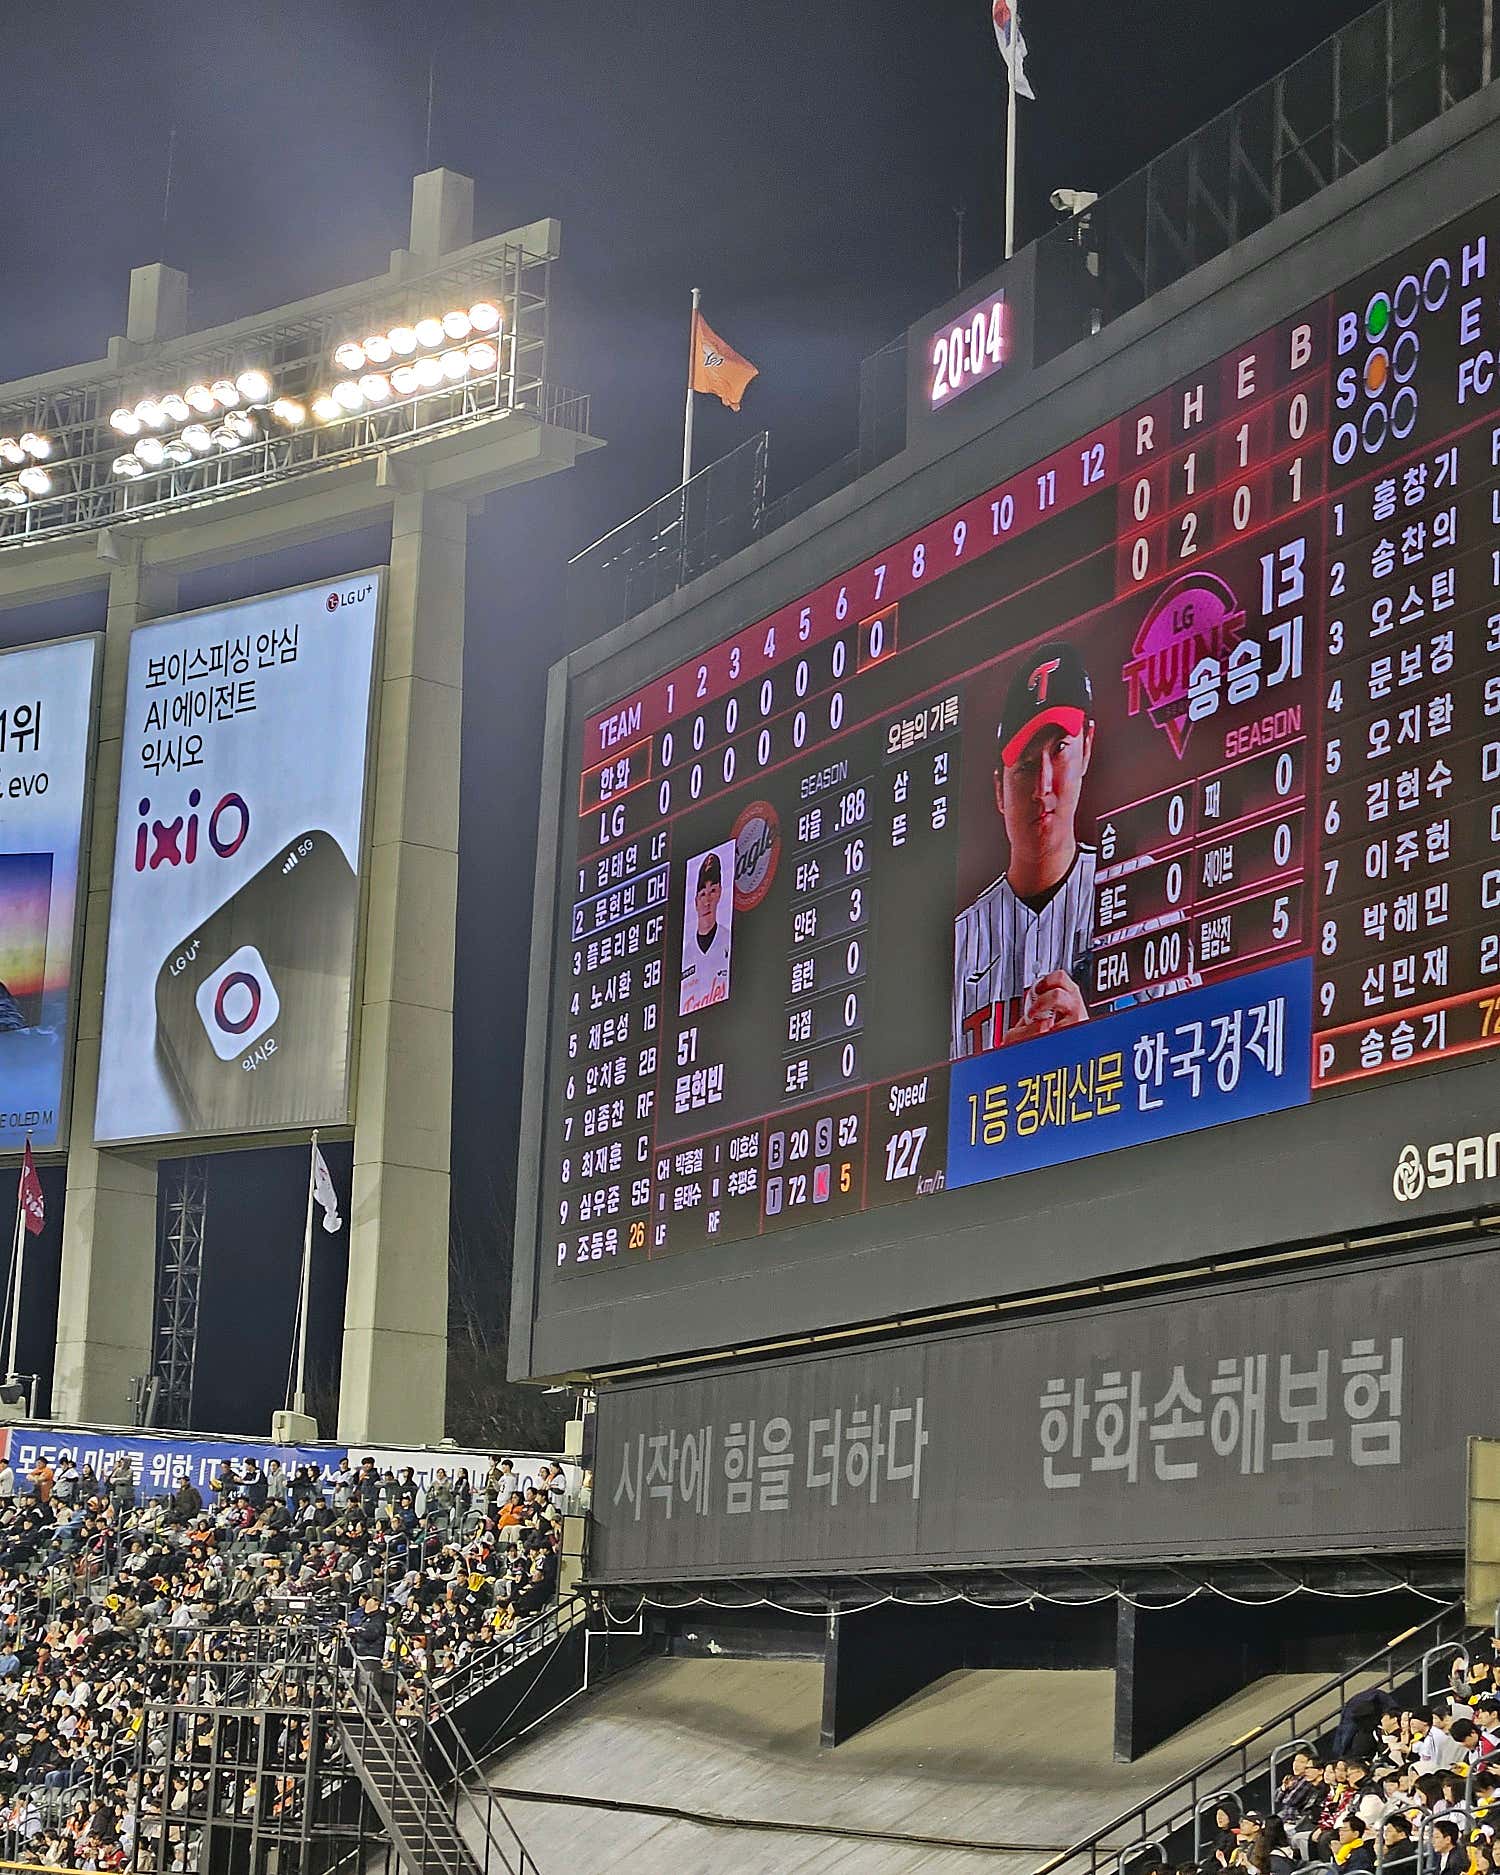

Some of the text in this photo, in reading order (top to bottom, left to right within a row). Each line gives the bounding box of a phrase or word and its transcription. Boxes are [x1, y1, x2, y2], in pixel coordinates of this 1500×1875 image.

[1462, 236, 1486, 286] H
[1338, 311, 1358, 356] B
[1460, 297, 1481, 346] E
[931, 302, 1005, 402] 20:04
[1458, 350, 1494, 404] FC
[1336, 367, 1357, 409] S
[1372, 447, 1458, 521] 홍창기
[600, 324, 1312, 750] TEAM 1 2 3 4 5 6 7 8 9 10 11 12 R H E B
[1371, 506, 1457, 579] 송찬의
[600, 393, 1308, 799] 한화 0 0 0 0 0 0 0 0 1 1 0
[1259, 537, 1306, 616] 13
[1369, 568, 1455, 638] 오스틴
[145, 623, 299, 689] 보이스피싱 안심
[600, 457, 1302, 845] LG 0 0 0 0 0 0 0 2 0 1
[1188, 615, 1303, 722] 송승기
[1368, 630, 1454, 700] 문보경
[144, 680, 256, 733] AI 에이전트
[887, 695, 959, 754] 오늘의 기록
[1224, 704, 1301, 759] SEASON
[1366, 692, 1453, 759] 오지환
[141, 734, 203, 776] 익시오
[801, 760, 848, 799] SEASON
[8, 772, 49, 798] evo
[1101, 752, 1292, 860] 승 0 패 0
[1366, 759, 1452, 822] 김현수
[798, 788, 865, 842] 타율 .188
[298, 839, 313, 857] 5G
[597, 832, 666, 888] 김태연 LF
[796, 839, 864, 891] 타수 16
[1365, 819, 1450, 879] 이주헌
[648, 873, 666, 903] DH
[1100, 824, 1291, 926] 홀드 0 세이브 0
[794, 888, 861, 943] 안타 3
[1363, 882, 1449, 942] 박해민
[587, 916, 663, 971] 플로리얼 CF
[791, 941, 859, 993] 홈런 0
[1097, 896, 1289, 992] ERA 0.00 탈삼진 5
[590, 960, 661, 1010] 노시환 3B
[1362, 945, 1448, 1007] 신민재
[589, 1004, 656, 1050] 채은성 1B
[789, 993, 856, 1041] 타점 0
[242, 1038, 279, 1072] 익시오
[678, 1028, 697, 1066] 51
[785, 1043, 855, 1093] 도루 0
[1319, 1010, 1446, 1078] P 송승기
[586, 1047, 657, 1095] 안치홍 2B
[675, 1063, 724, 1114] 문현빈
[889, 1077, 928, 1116] Speed
[968, 997, 1286, 1146] 1등 경제신문 한국경제
[9, 1111, 40, 1127] OLED
[584, 1091, 654, 1137] 임종찬 RF
[789, 1115, 858, 1160] 20 52
[581, 1135, 648, 1178] 최재훈 C
[657, 1158, 670, 1181] CH
[729, 1132, 759, 1162] 이호성
[885, 1126, 928, 1181] 127
[580, 1179, 650, 1221] 심우준 SS
[788, 1164, 851, 1206] 72 5
[916, 1172, 945, 1195] km/h
[557, 1221, 645, 1266] P 조동욱 26
[655, 1224, 666, 1245] LF
[708, 1210, 720, 1233] RF
[613, 1337, 1403, 1521] 시작에 힘을 더하다 한화손해보험
